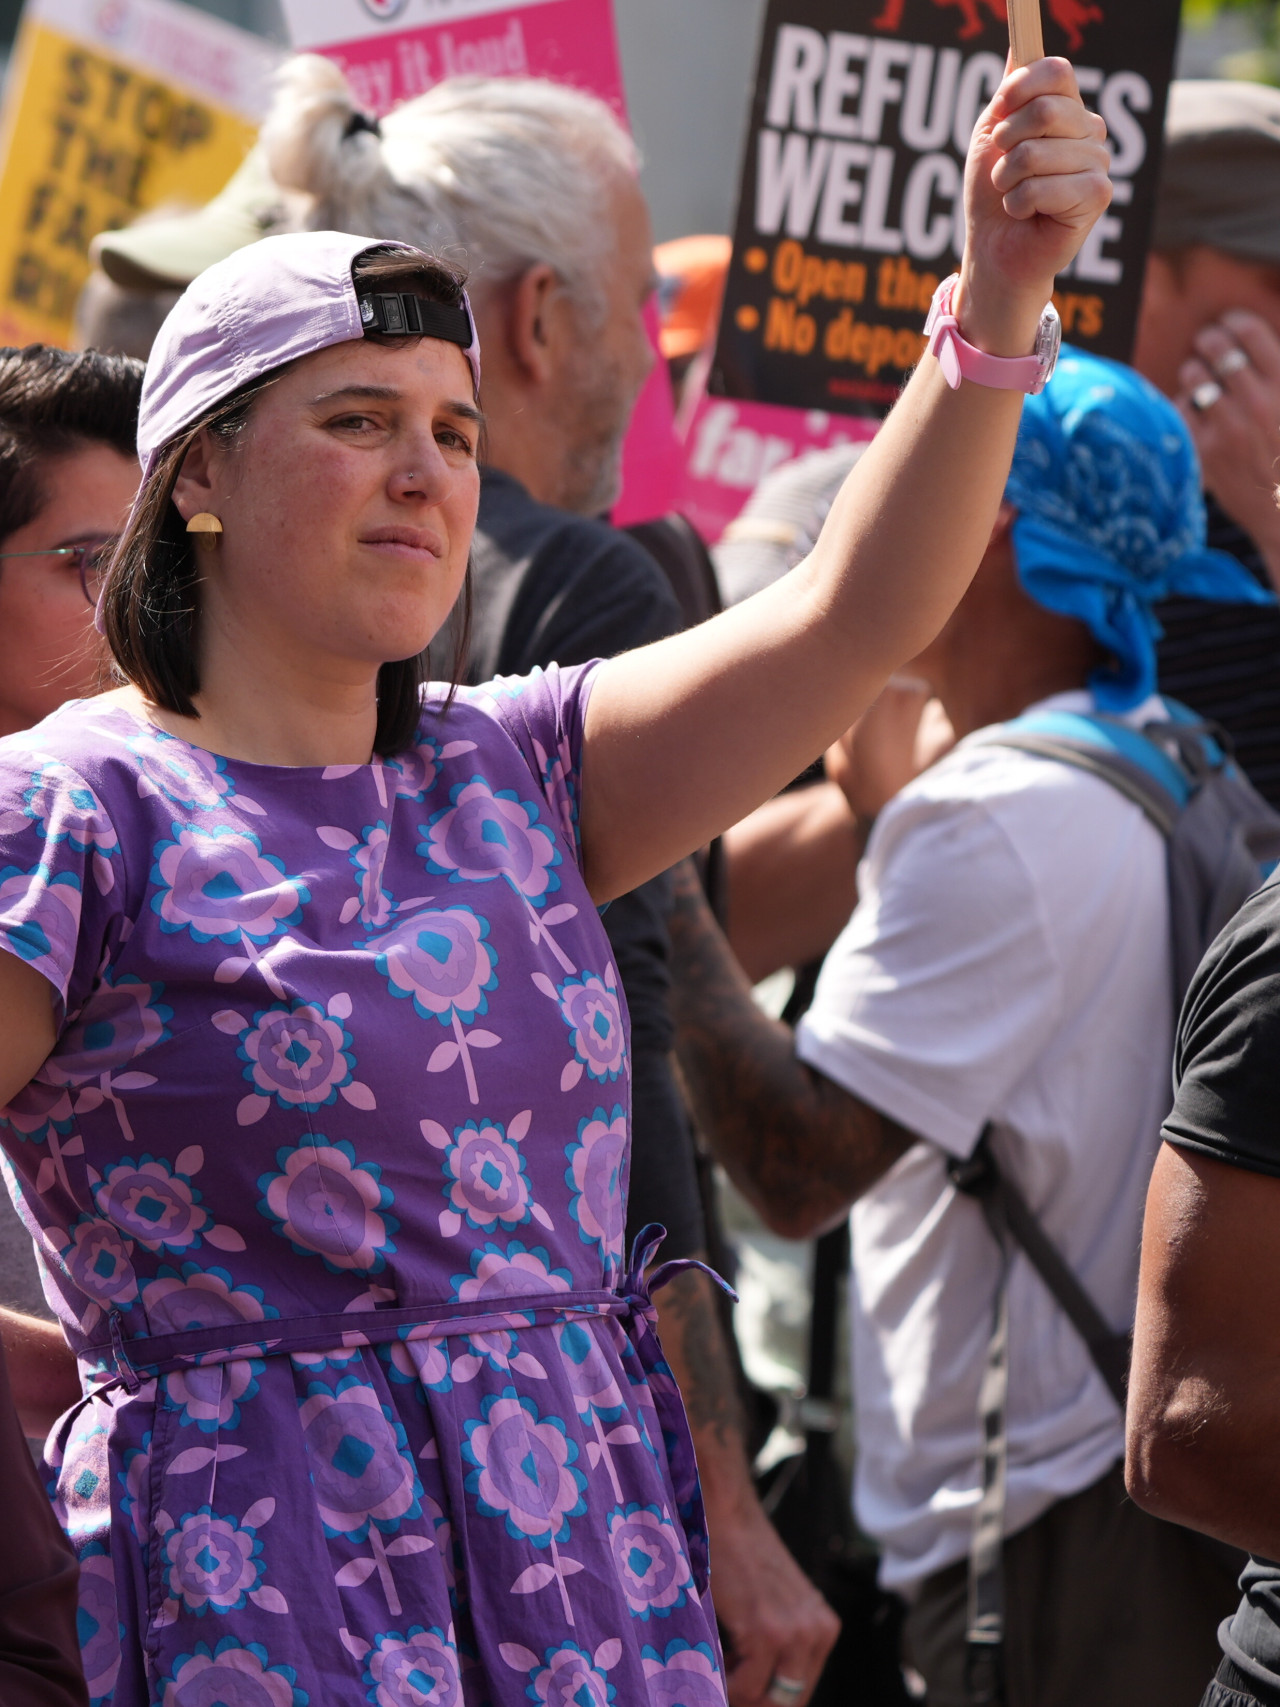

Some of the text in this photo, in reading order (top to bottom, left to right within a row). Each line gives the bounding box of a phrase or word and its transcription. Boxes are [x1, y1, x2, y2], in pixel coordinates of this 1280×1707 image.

[754, 130, 1133, 286] WELCE
[773, 238, 940, 314] Open the
[763, 297, 817, 356] No
